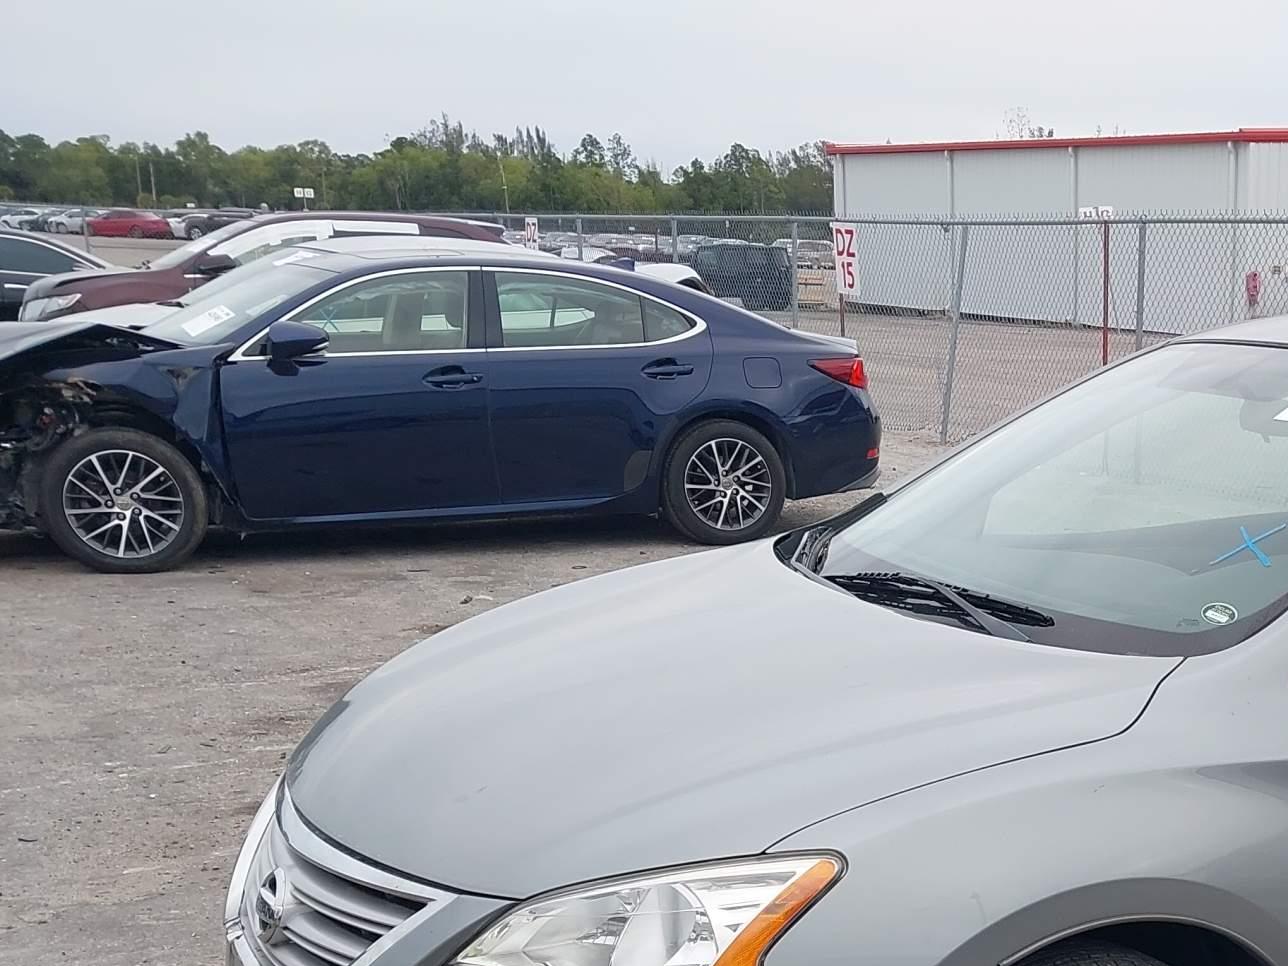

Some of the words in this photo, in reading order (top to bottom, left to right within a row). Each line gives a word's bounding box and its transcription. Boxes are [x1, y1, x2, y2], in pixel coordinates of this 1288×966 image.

[526, 221, 537, 243] DZ
[835, 228, 856, 258] DZ
[841, 261, 855, 289] 15
